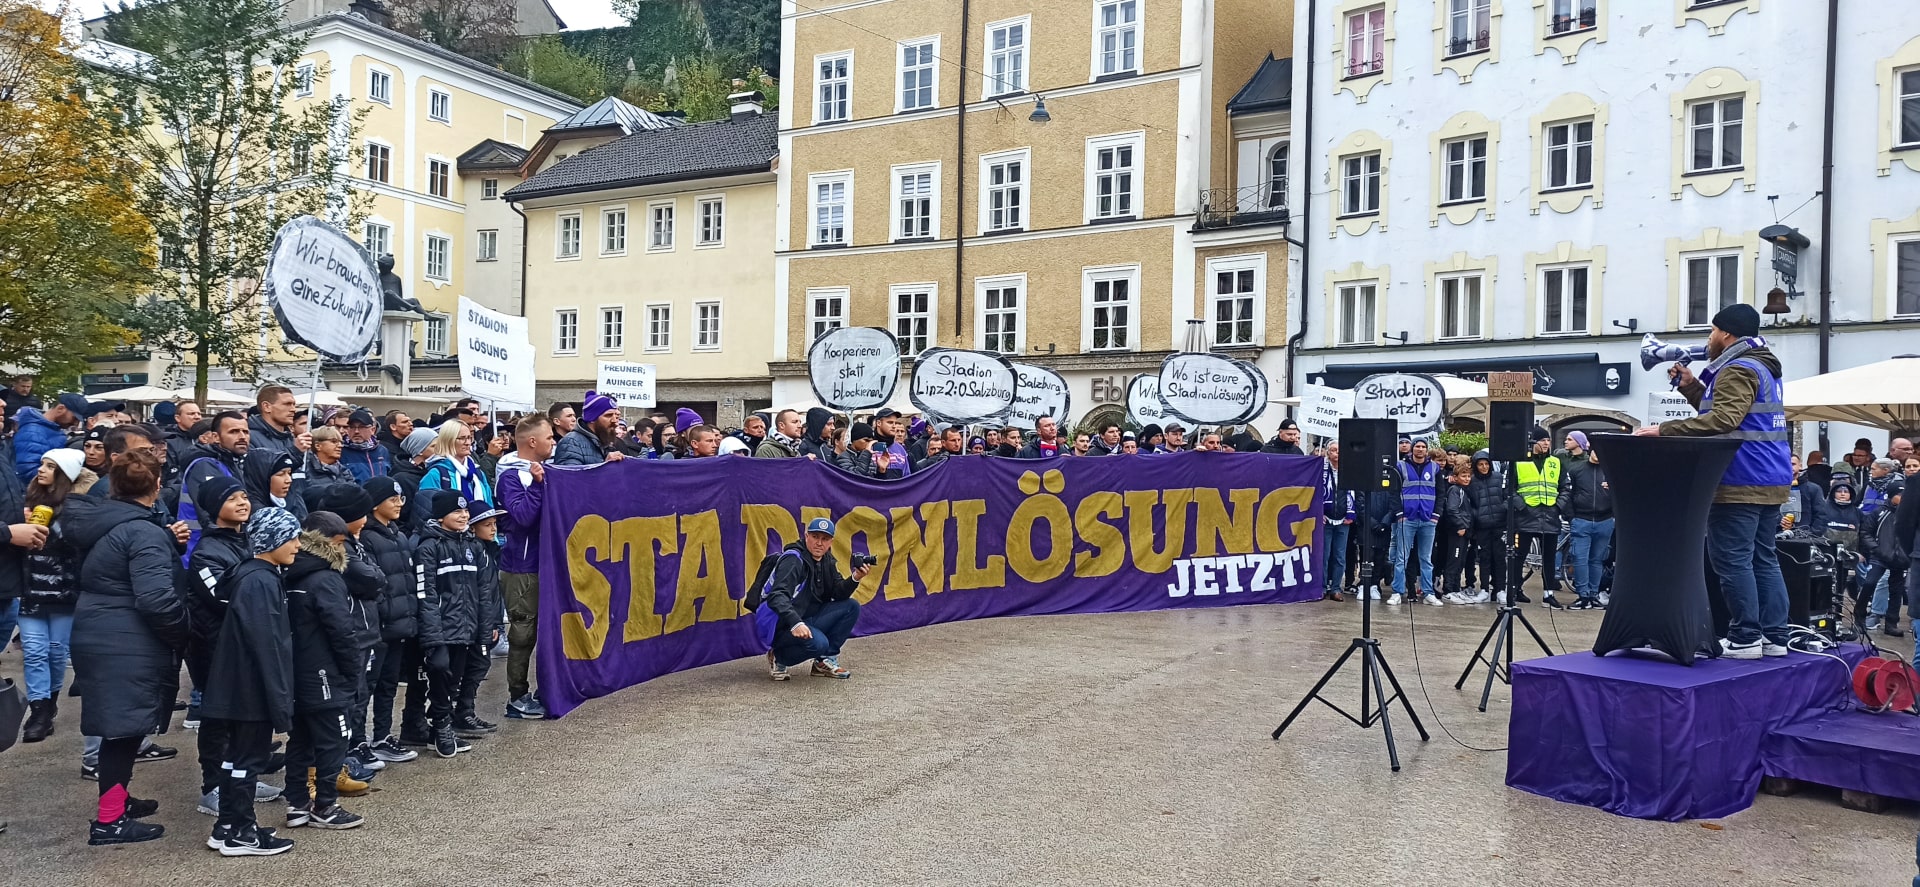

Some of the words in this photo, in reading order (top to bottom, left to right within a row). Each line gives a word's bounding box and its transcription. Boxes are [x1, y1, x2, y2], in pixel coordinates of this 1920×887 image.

[296, 229, 325, 265] Wir
[291, 278, 321, 305] eine
[321, 284, 374, 336] Zukunft!
[468, 309, 508, 335] STADION
[469, 337, 508, 361] LÖSUNG
[824, 342, 881, 361] Kooperieren
[839, 361, 865, 379] statt
[936, 355, 992, 378] Stadion
[1172, 361, 1188, 380] Wo
[1194, 368, 1211, 384] ist
[1211, 374, 1239, 385] eure
[606, 378, 644, 387] AUINGER
[833, 375, 887, 401] blockieren!
[916, 376, 944, 396] Linz
[966, 380, 1011, 402] Salzburg
[1017, 373, 1061, 396] Salzburg
[1091, 375, 1128, 402] Eibl
[1139, 379, 1159, 400] Wir
[1491, 373, 1529, 384] STADION
[629, 393, 651, 401] WAS!
[1166, 382, 1253, 405] Stadionlösung?
[1322, 395, 1336, 404] PRO
[1365, 381, 1432, 401] Stadion
[1386, 397, 1431, 419] jetzt!
[1308, 417, 1338, 429] STADION
[561, 468, 1316, 660] STADONLÖSUNG
[1167, 546, 1313, 599] JETZT!
